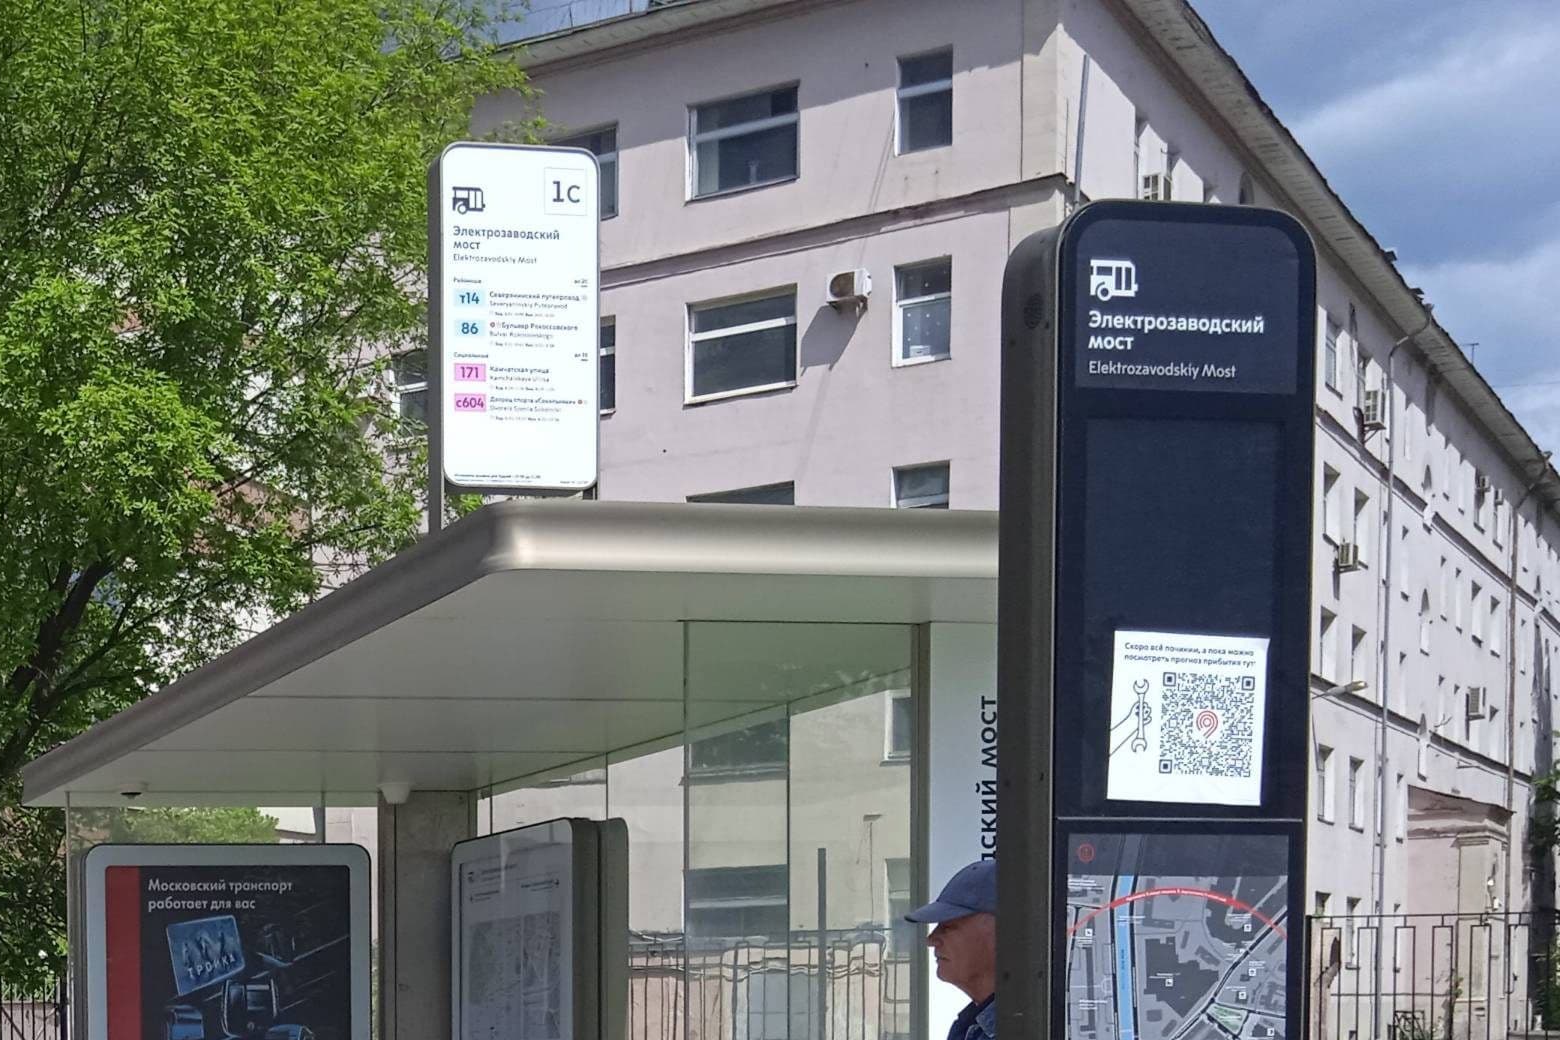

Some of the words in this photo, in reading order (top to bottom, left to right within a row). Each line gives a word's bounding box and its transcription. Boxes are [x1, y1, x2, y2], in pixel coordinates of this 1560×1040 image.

[453, 225, 560, 240] Электрозаводский
[453, 241, 481, 250] мост
[517, 256, 537, 264] Most
[459, 291, 481, 305] т14
[461, 322, 479, 335] 86
[1088, 310, 1265, 334] Электрозаводский
[1088, 335, 1135, 350] мост
[460, 366, 479, 379] 171
[1089, 360, 1200, 380] Elektrozavodskiy
[1201, 364, 1236, 378] Most
[1124, 642, 1149, 652] Скоро
[1124, 654, 1169, 663] посмотреть
[1171, 656, 1202, 665] прогноз
[1203, 658, 1241, 667] прибытия
[148, 878, 226, 892] Московский
[228, 881, 293, 895] транспорт
[148, 896, 208, 912] работает
[210, 899, 232, 910] для
[235, 900, 256, 909] вас
